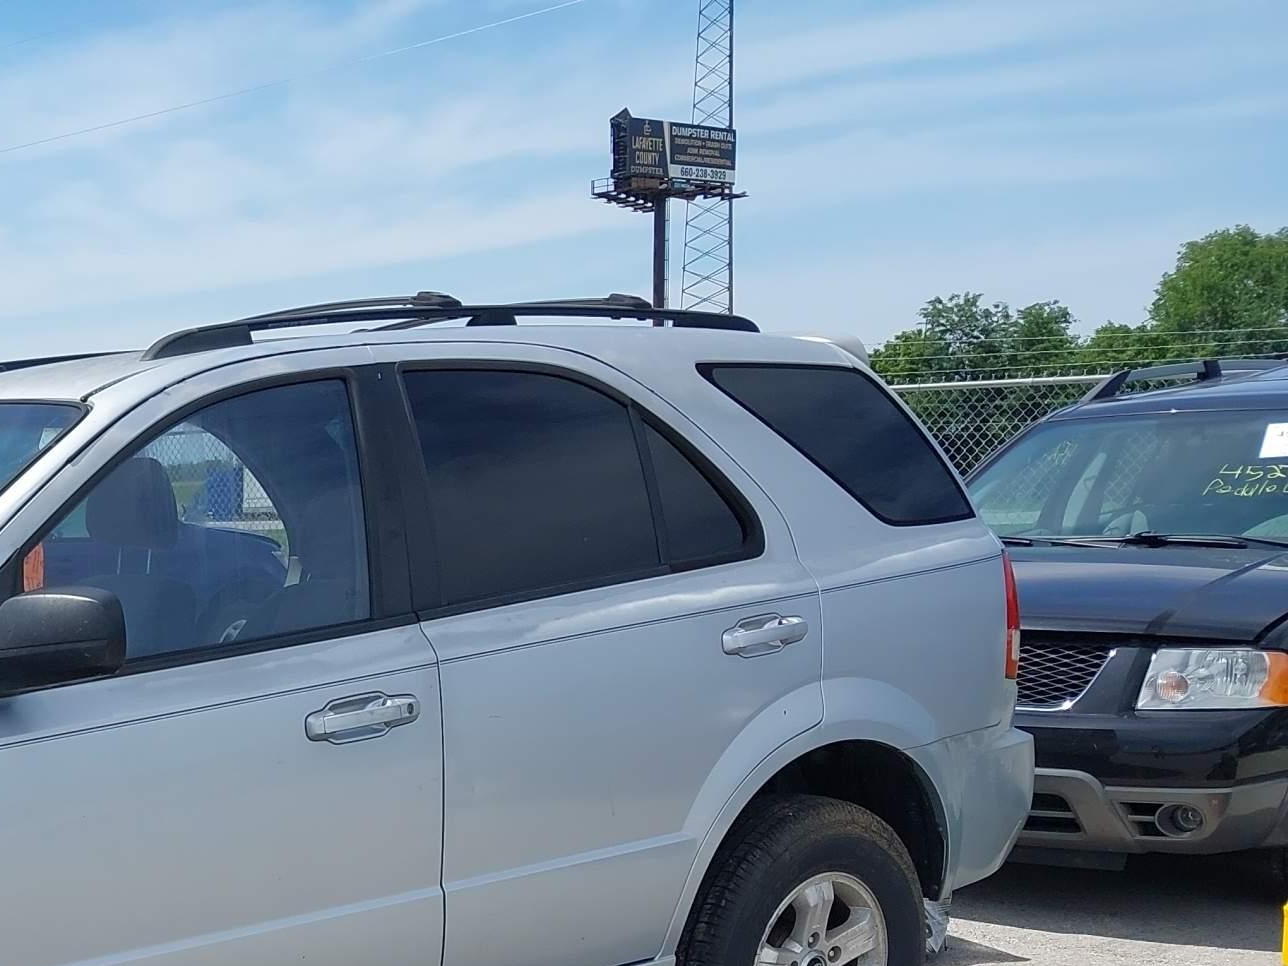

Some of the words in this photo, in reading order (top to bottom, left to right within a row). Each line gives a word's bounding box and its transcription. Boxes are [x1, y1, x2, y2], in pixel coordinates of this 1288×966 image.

[672, 126, 709, 139] DUMPSTER
[710, 130, 735, 142] RENTAL
[632, 135, 663, 151] LAFAYETTE
[635, 151, 660, 165] COUNTY
[680, 166, 727, 180] 660-238-3929
